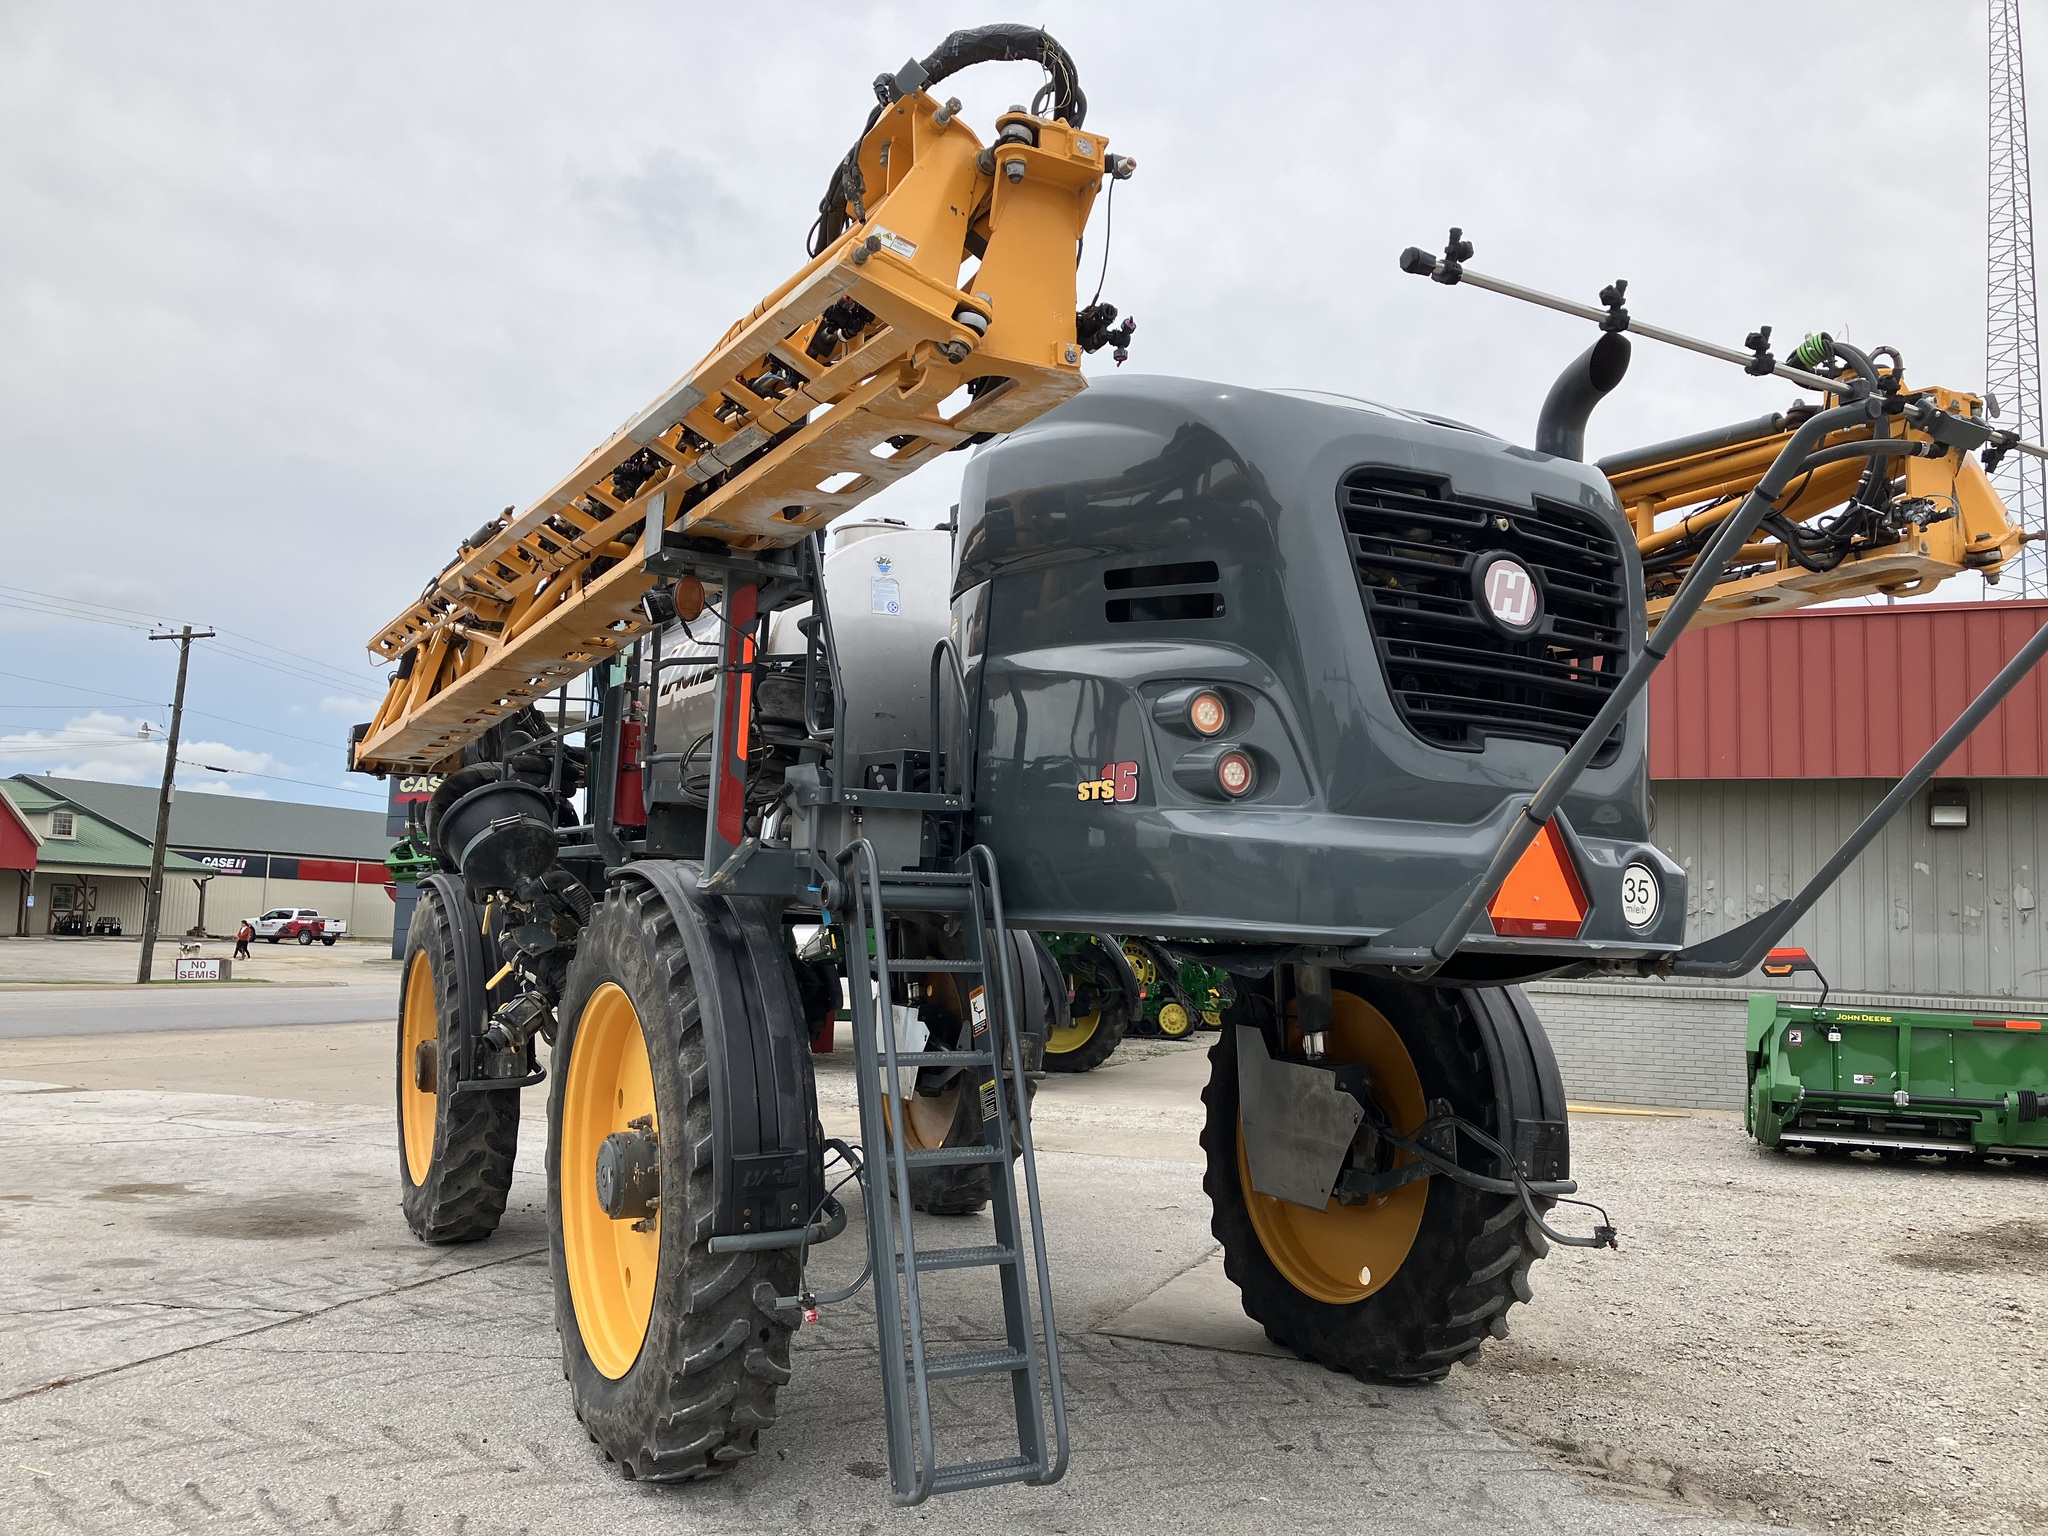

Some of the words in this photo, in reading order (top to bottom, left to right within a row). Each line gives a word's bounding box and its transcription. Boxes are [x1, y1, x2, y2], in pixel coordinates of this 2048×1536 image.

[399, 776, 444, 793] CAS
[1077, 779, 1115, 801] STS
[201, 856, 235, 868] CASE
[1624, 877, 1649, 905] 35
[191, 960, 207, 969] NO
[179, 970, 217, 979] SEMIS
[1836, 1013, 1861, 1021] JOHN
[1861, 1014, 1892, 1023] DEERE
